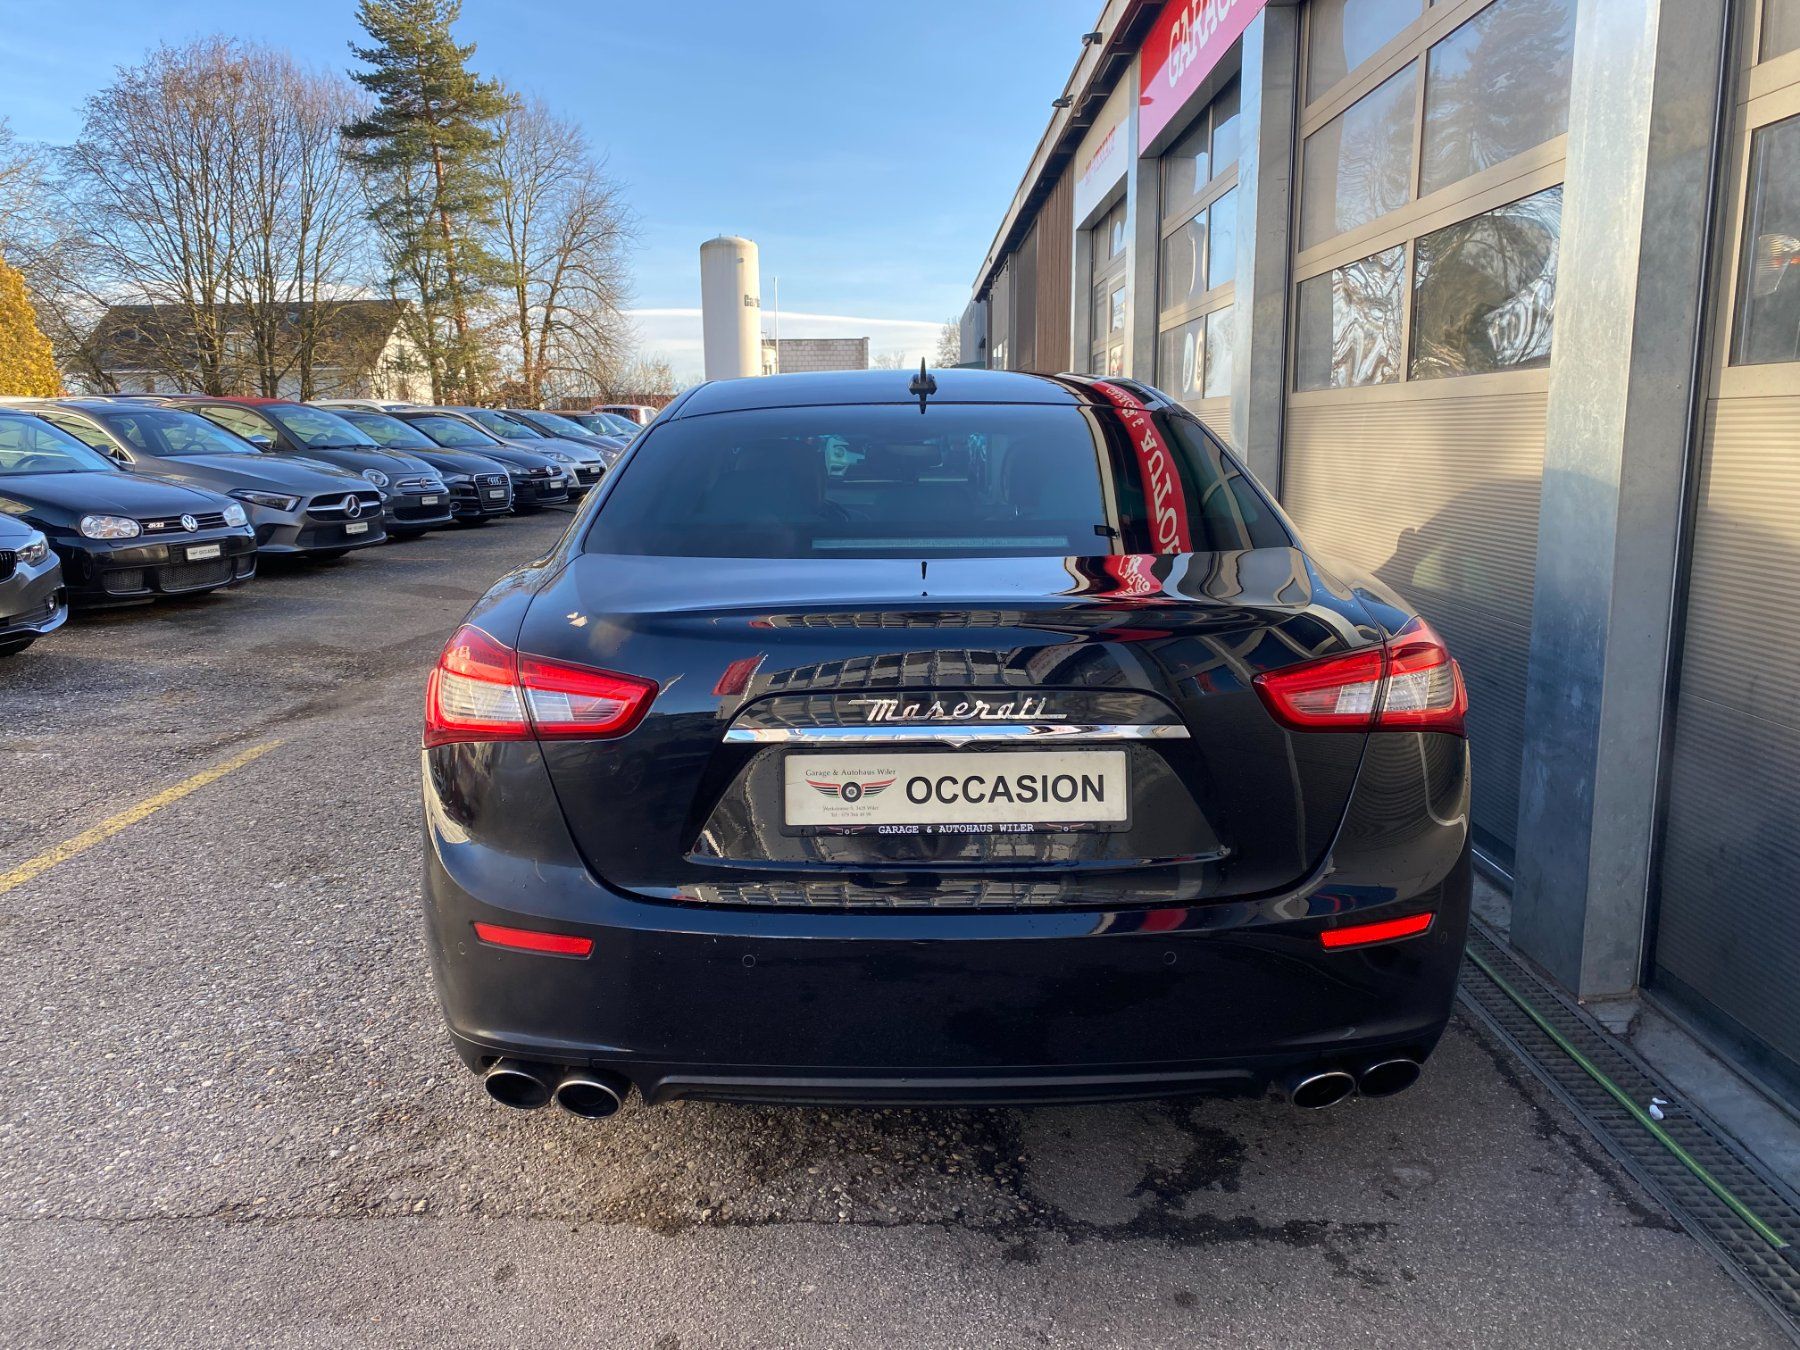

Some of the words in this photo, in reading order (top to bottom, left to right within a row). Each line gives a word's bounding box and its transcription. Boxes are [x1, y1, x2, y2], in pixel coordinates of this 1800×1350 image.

[1168, 0, 1237, 87] GARA
[848, 696, 1067, 722] Maserati
[805, 769, 831, 777] Garage
[841, 768, 875, 776] Autohaus
[905, 774, 1105, 804] OCCASION
[878, 825, 919, 834] GARAGE
[926, 825, 933, 833] &
[938, 824, 993, 833] AUTOHAUS
[1000, 823, 1034, 833] WILER
